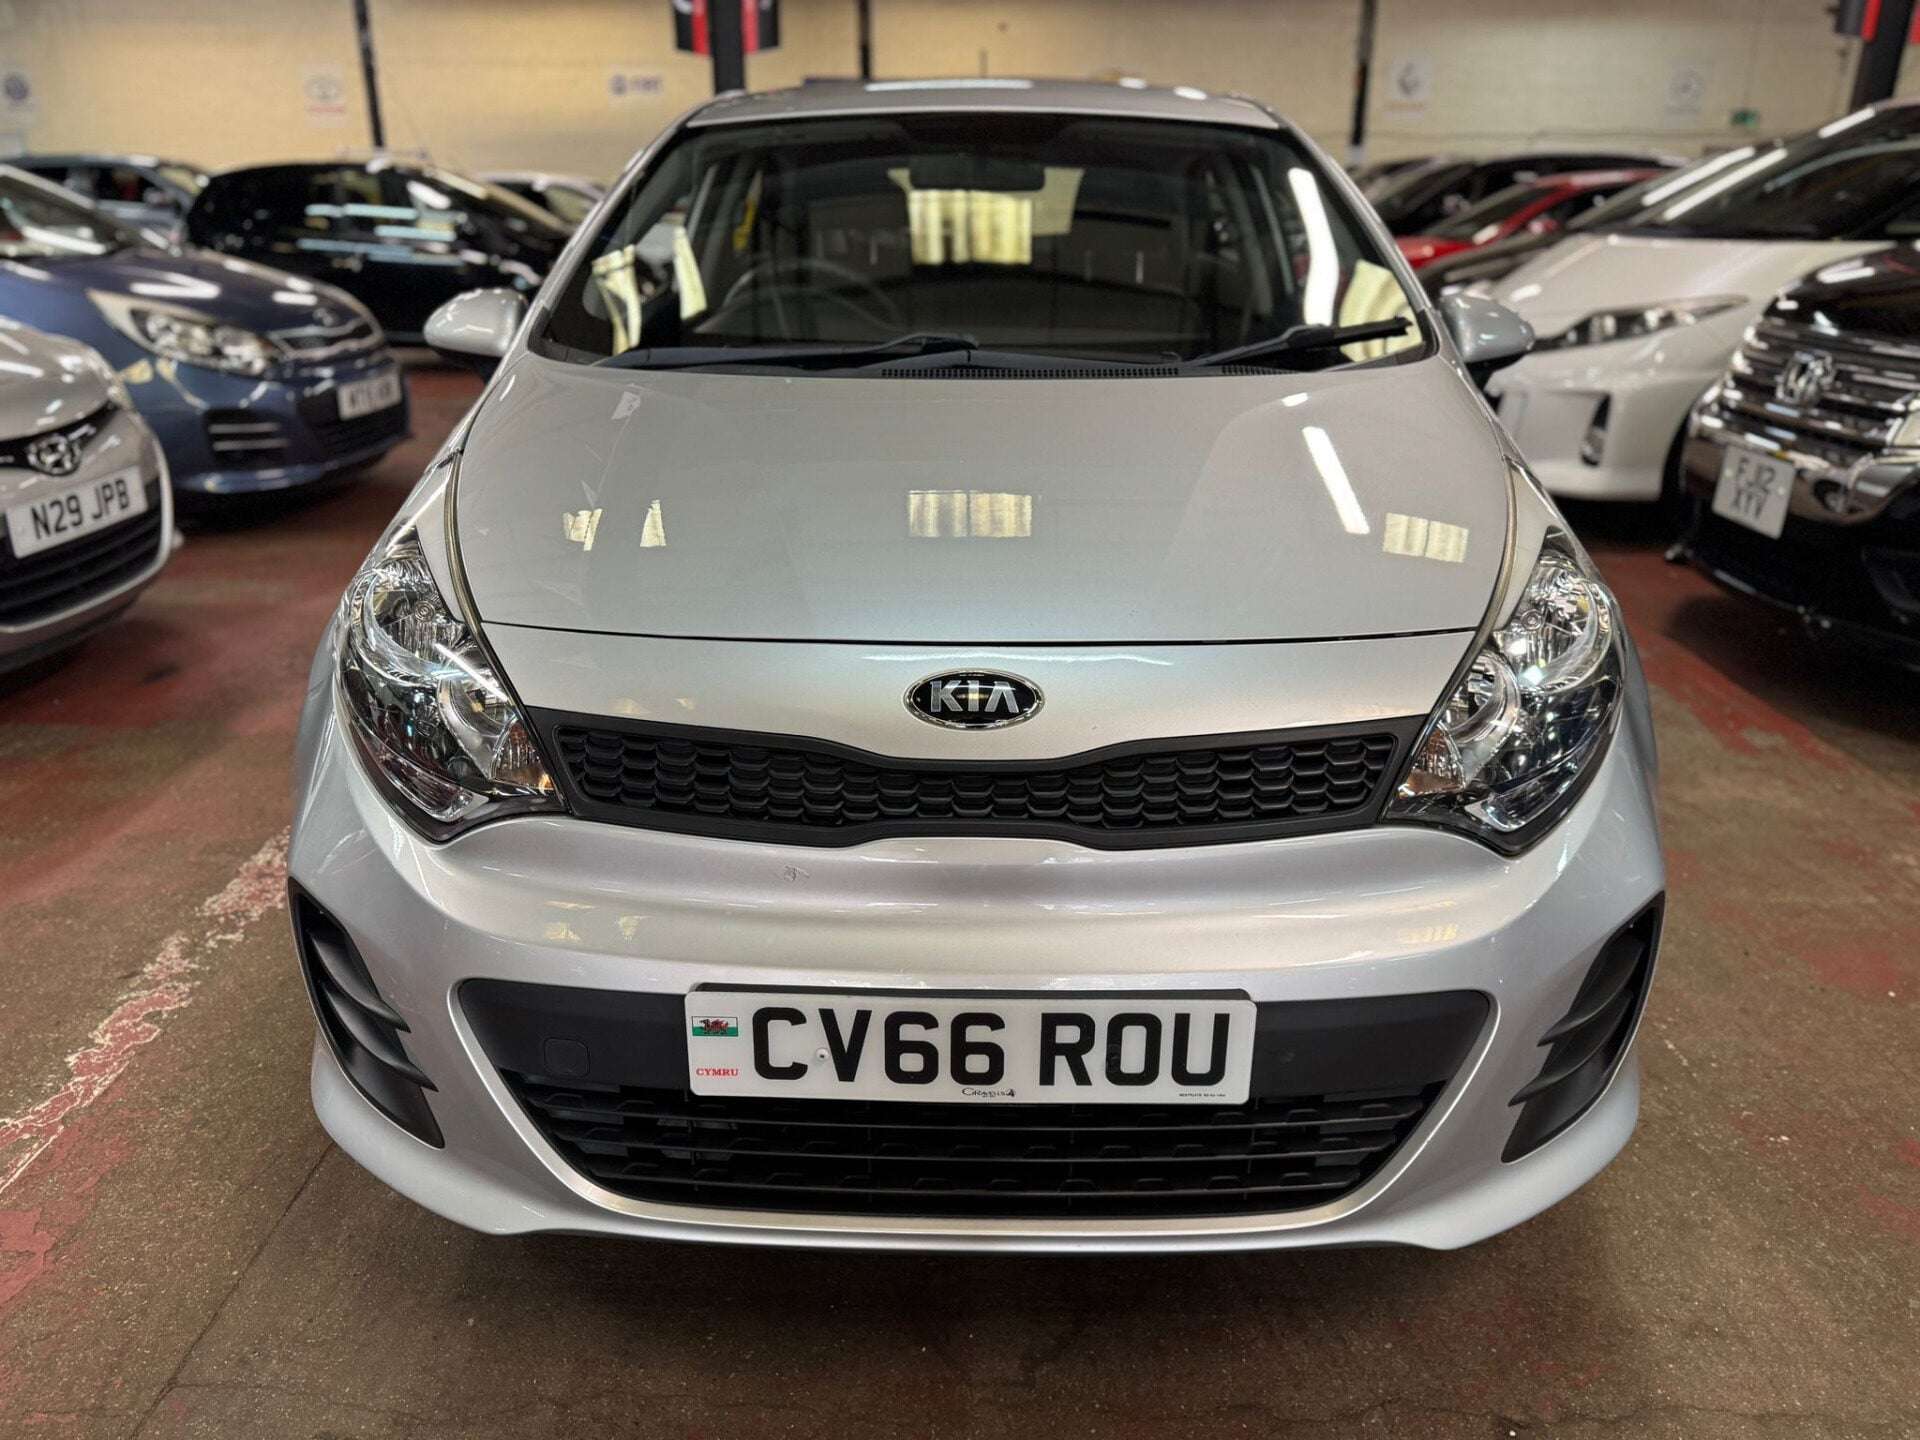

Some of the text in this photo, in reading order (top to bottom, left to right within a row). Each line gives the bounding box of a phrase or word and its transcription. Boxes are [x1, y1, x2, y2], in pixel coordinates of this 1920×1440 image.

[30, 478, 130, 541] N29 JPB
[929, 679, 1020, 714] KIA
[751, 1006, 1231, 1087] CV66 ROU
[695, 1067, 739, 1077] CYMRU
